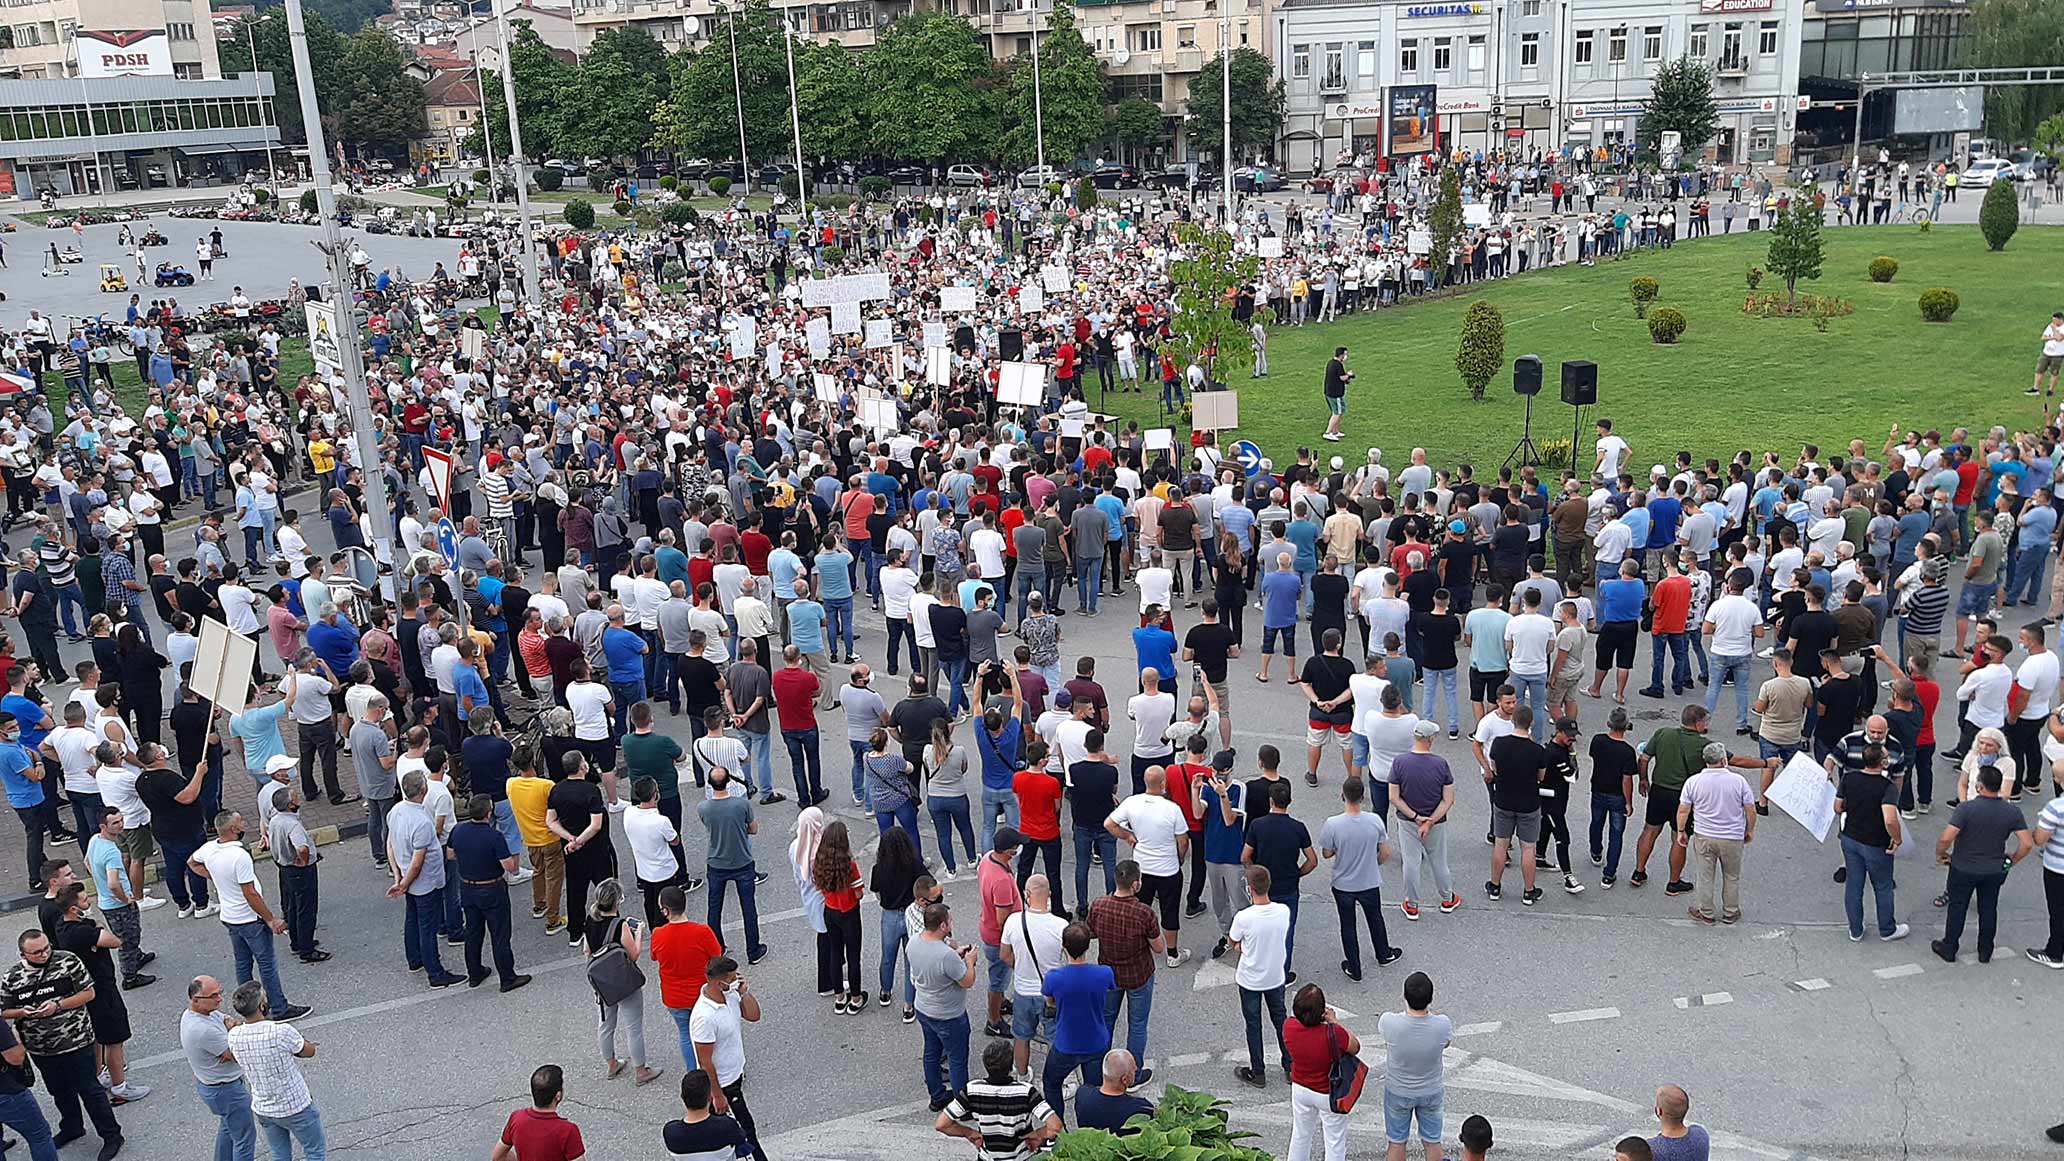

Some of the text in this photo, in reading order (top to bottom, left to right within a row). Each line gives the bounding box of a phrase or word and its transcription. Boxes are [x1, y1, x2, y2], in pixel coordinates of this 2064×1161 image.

[1723, 0, 1770, 9] EDUCATION
[1407, 4, 1471, 17] SECURITAS
[101, 53, 150, 66] PDSH
[1353, 104, 1380, 115] ProCredi
[1463, 101, 1480, 109] Bank
[1863, 487, 1875, 498] 14
[18, 986, 55, 1000] UNKOWN
